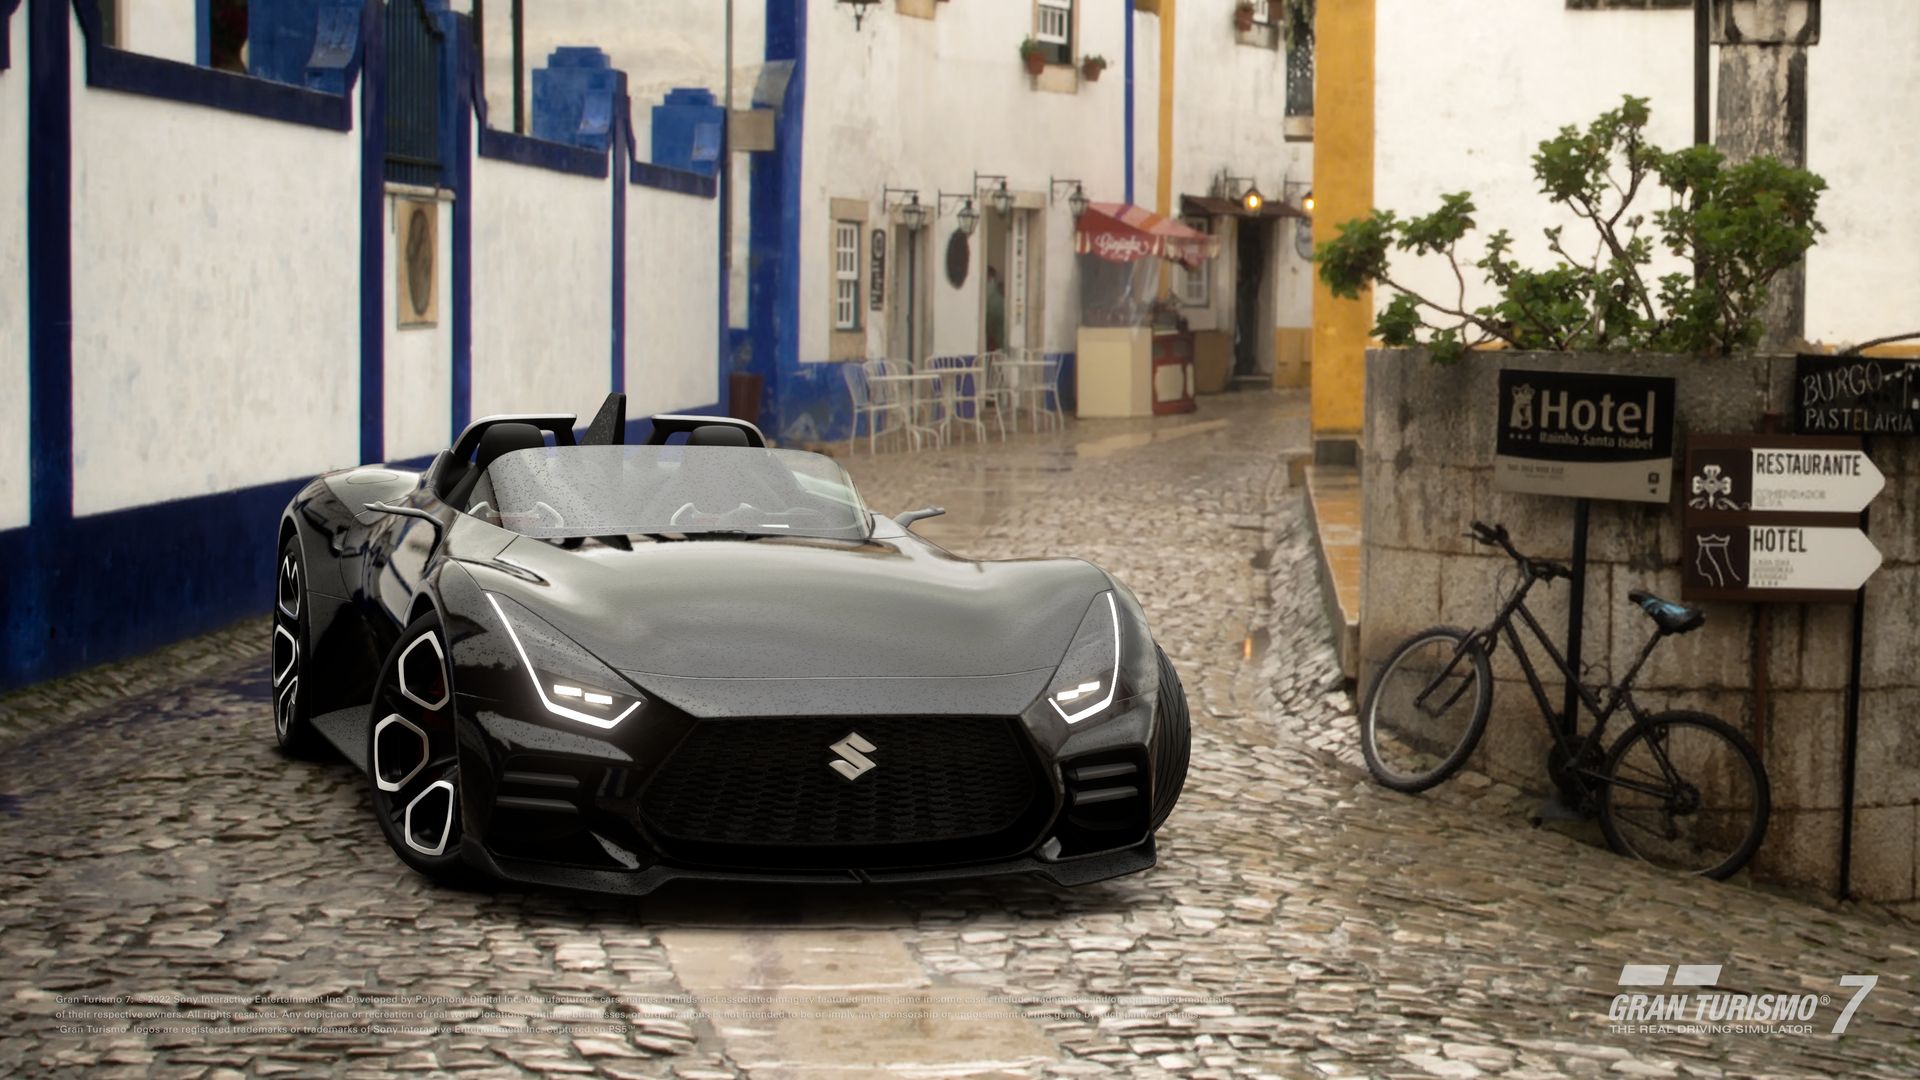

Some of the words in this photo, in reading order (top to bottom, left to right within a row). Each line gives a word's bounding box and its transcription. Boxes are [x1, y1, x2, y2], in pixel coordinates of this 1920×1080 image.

[1803, 362, 1882, 406] BURGO
[1540, 390, 1655, 435] Hotel
[1805, 408, 1913, 432] PASTELARIA
[1539, 432, 1579, 445] Rainha
[1583, 434, 1615, 447] Santa
[1618, 436, 1653, 450] Isabel
[1756, 452, 1862, 477] RESTAURANTE
[1753, 528, 1808, 552] HOTEL
